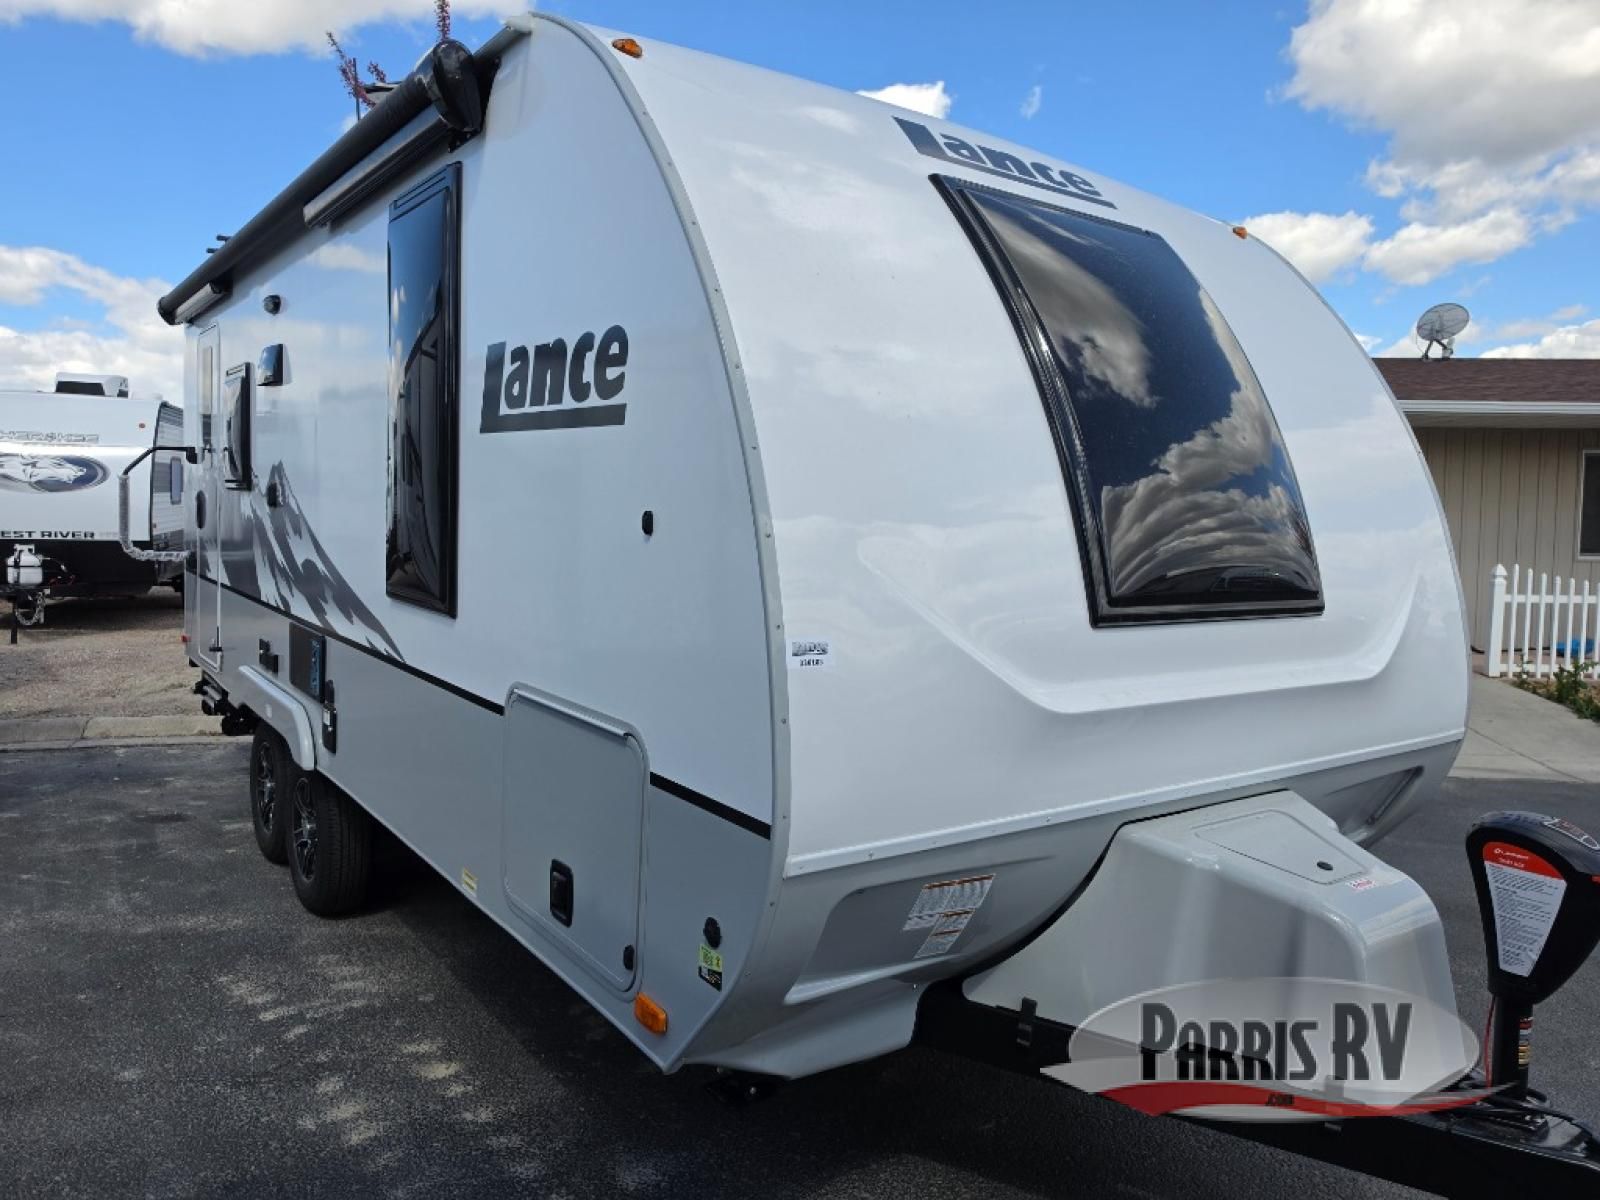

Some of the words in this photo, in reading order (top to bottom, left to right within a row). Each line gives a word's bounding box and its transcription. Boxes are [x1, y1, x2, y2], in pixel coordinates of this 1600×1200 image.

[892, 115, 1118, 210] Lance
[480, 324, 629, 434] Lance
[41, 530, 95, 539] RIVER
